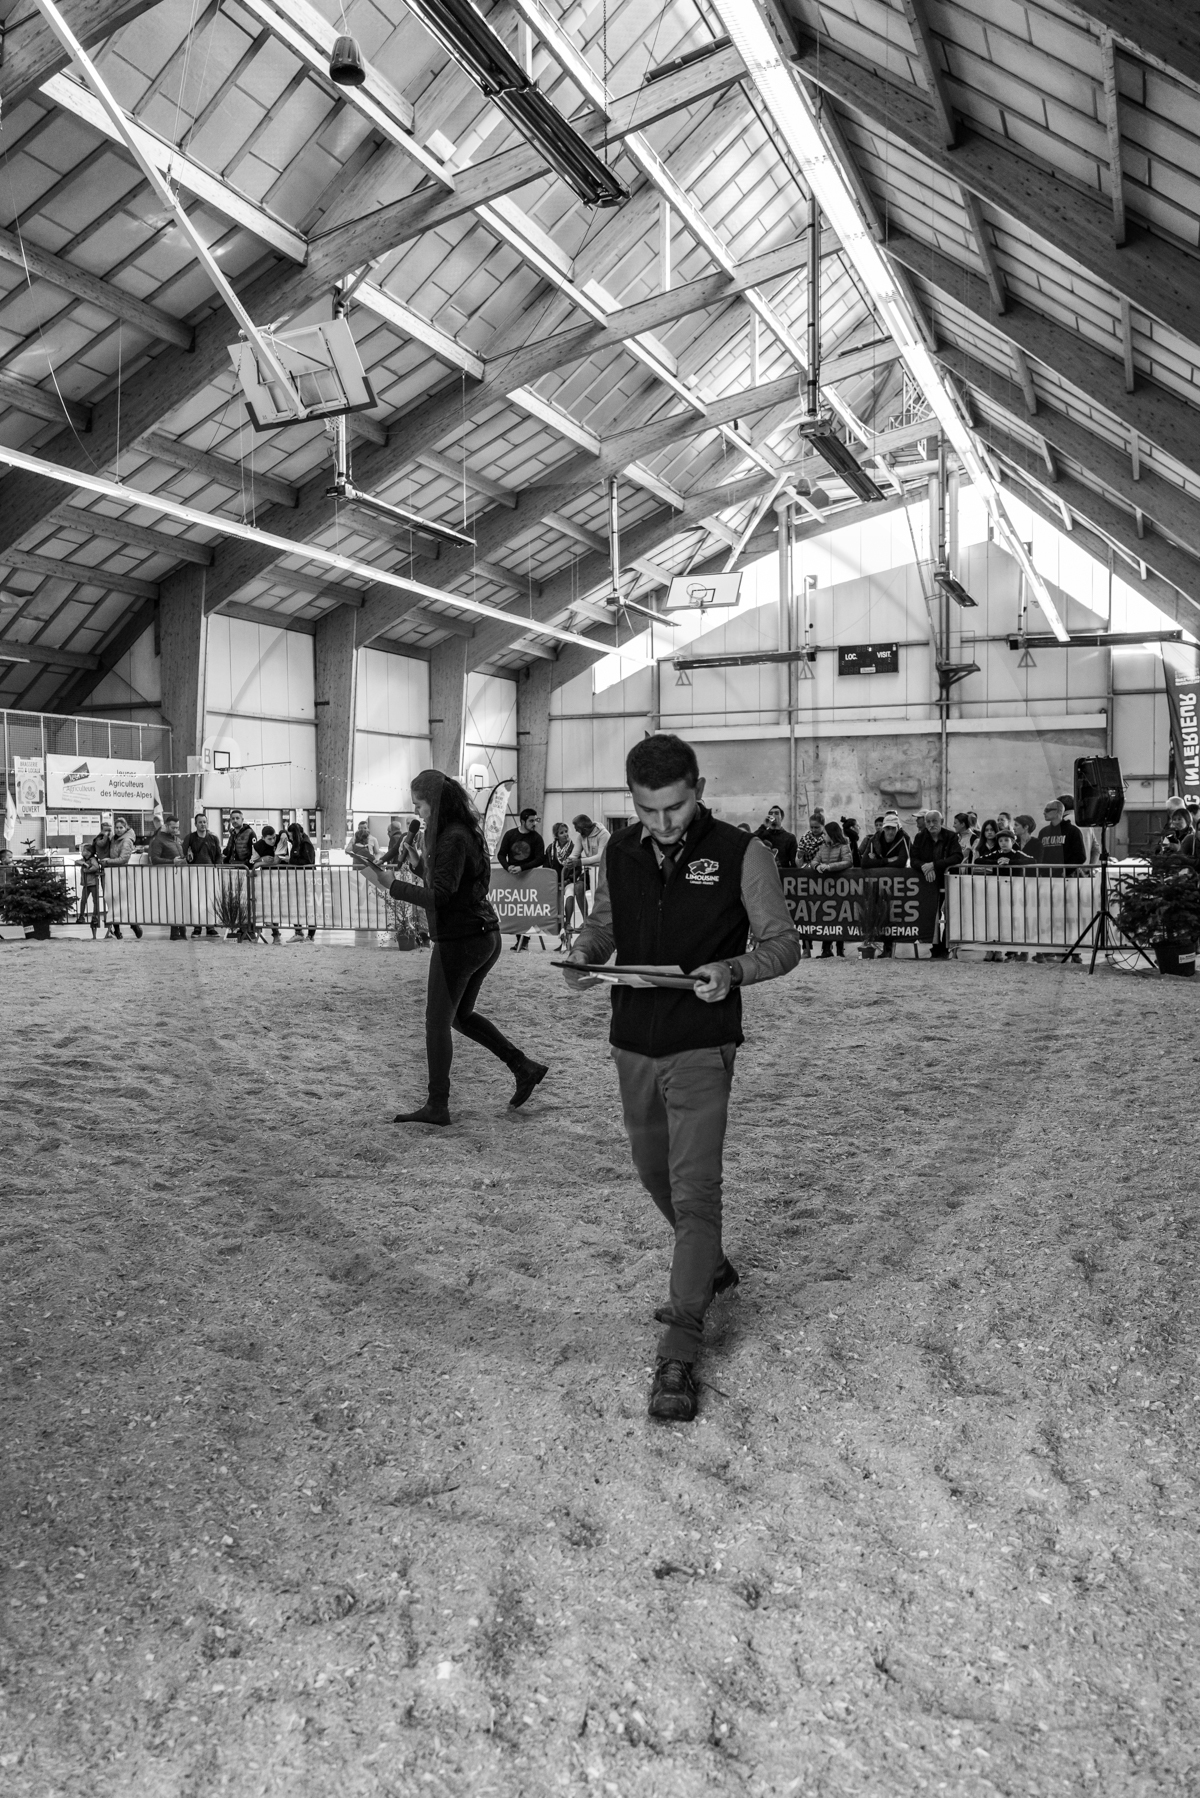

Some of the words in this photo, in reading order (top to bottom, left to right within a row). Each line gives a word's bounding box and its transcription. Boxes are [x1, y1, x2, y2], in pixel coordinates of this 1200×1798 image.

[108, 779, 144, 788] Agriculteurs
[100, 789, 111, 797] des
[112, 790, 153, 800] Hautes-Alpes
[21, 805, 40, 813] OUVERT
[685, 873, 719, 881] LIMOUSINE
[783, 876, 920, 897] RENCONTRES
[486, 888, 538, 902] MPSAUR
[493, 903, 551, 916] AUDEMAR
[785, 899, 920, 922] PAYSANES
[793, 924, 843, 936] AMPSAUR
[847, 925, 919, 936] VALAUDEMAR
